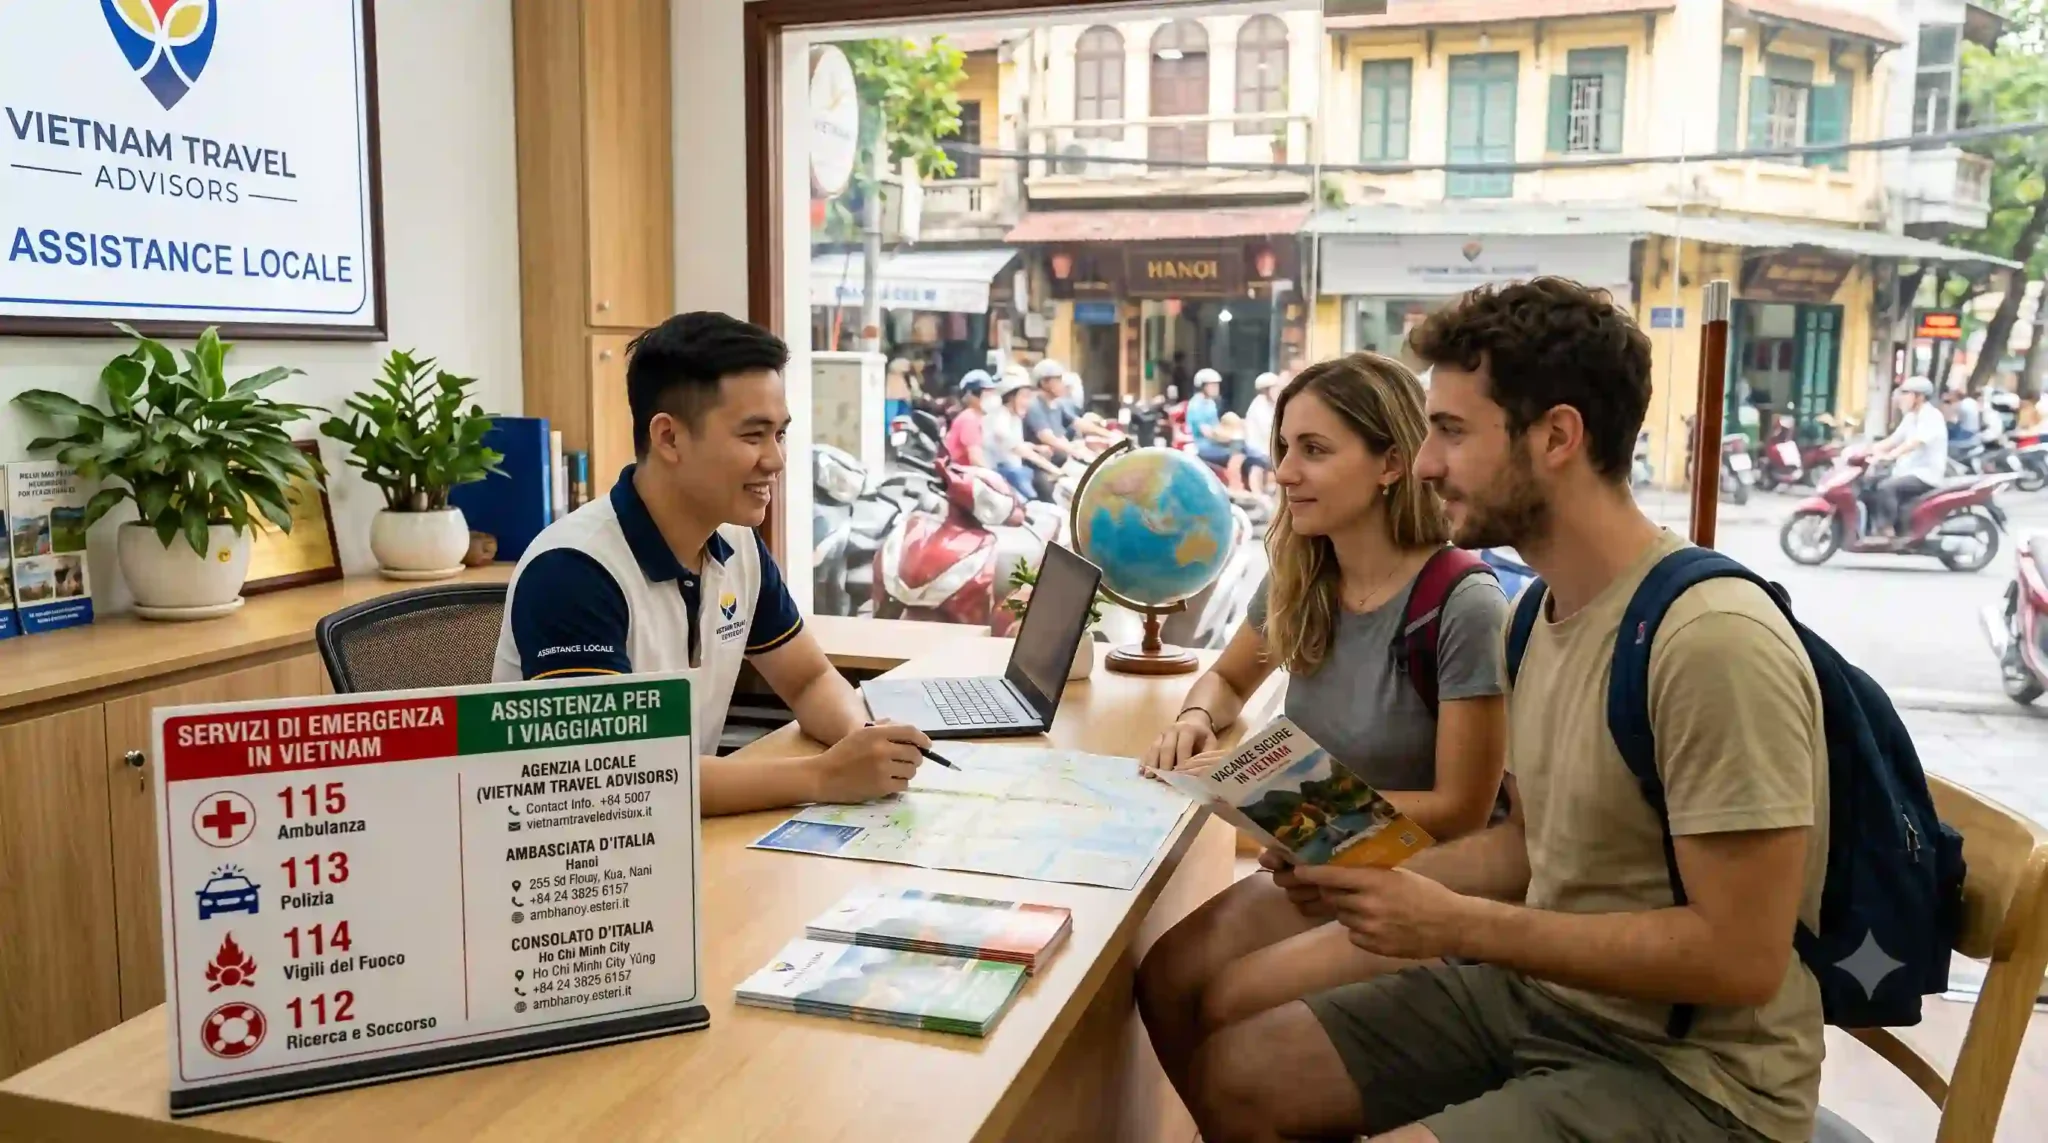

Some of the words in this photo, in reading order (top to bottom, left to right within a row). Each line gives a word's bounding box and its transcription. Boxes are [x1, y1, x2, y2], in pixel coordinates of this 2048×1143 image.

[6, 107, 172, 162] VIETNAM
[182, 135, 297, 178] TRAVEL
[95, 165, 239, 203] ADVISORS
[9, 227, 233, 276] ASSISTANCE
[244, 247, 352, 283] LOCALE
[1148, 260, 1218, 279] HANOI
[537, 644, 582, 658] ASSISTANCE
[583, 645, 615, 653] LOCALE
[491, 692, 617, 721] ASSISTENZA
[623, 689, 661, 710] PER
[178, 719, 270, 747] SERVIZI
[278, 717, 300, 738] DI
[308, 706, 444, 736] EMERGENZA
[507, 725, 513, 745] I
[520, 714, 647, 743] VIAGGIATORI
[248, 746, 272, 768] IN
[279, 737, 381, 765] VIETNAM
[521, 759, 580, 778] AGENZIA
[585, 755, 636, 772] LOCALE
[1211, 750, 1257, 783] VACANZE
[1254, 728, 1293, 755] SICURE
[1234, 772, 1250, 785] IN
[1245, 744, 1292, 777] VIETNAM
[277, 782, 346, 819] 115
[477, 781, 545, 804] (VIETNAM
[550, 776, 601, 794] TRAVEL
[606, 768, 678, 791] ADVISORS)
[526, 800, 567, 815] Contact
[571, 797, 595, 809] Info.
[600, 793, 621, 806] +84
[624, 791, 651, 803] 5007
[278, 819, 366, 840] Ambulanza
[506, 840, 595, 862] AMBASCIATA
[600, 832, 655, 851] D'ITALIA
[281, 852, 349, 888] 113
[529, 877, 550, 890] 255
[554, 875, 566, 887] Sd
[629, 864, 652, 877] Nani
[566, 856, 599, 871] Hanoi
[281, 891, 334, 910] Polizia
[530, 894, 550, 905] +84
[554, 891, 568, 902] 24
[571, 887, 599, 900] 3825
[602, 883, 629, 897] 6157
[530, 898, 630, 921] ambhanoy.esteri.it
[284, 920, 352, 958] 114
[511, 928, 594, 951] CONSOLATO
[599, 920, 654, 939] D'ITALIA
[284, 962, 325, 982] Vigili
[330, 958, 354, 974] del
[359, 953, 405, 971] Fuoco
[539, 950, 554, 963] Ho
[557, 947, 576, 960] Chi
[579, 943, 606, 957] Minh
[609, 941, 630, 955] City
[533, 968, 549, 979] Ho
[552, 965, 570, 976] Chi
[605, 957, 626, 970] City
[533, 980, 554, 994] +84
[556, 978, 570, 989] 24
[574, 974, 602, 988] 3825
[604, 970, 631, 984] 6157
[287, 990, 355, 1028] 112
[287, 1031, 347, 1050] Ricerca
[352, 1029, 361, 1040] e
[367, 1016, 437, 1038] Soccorso
